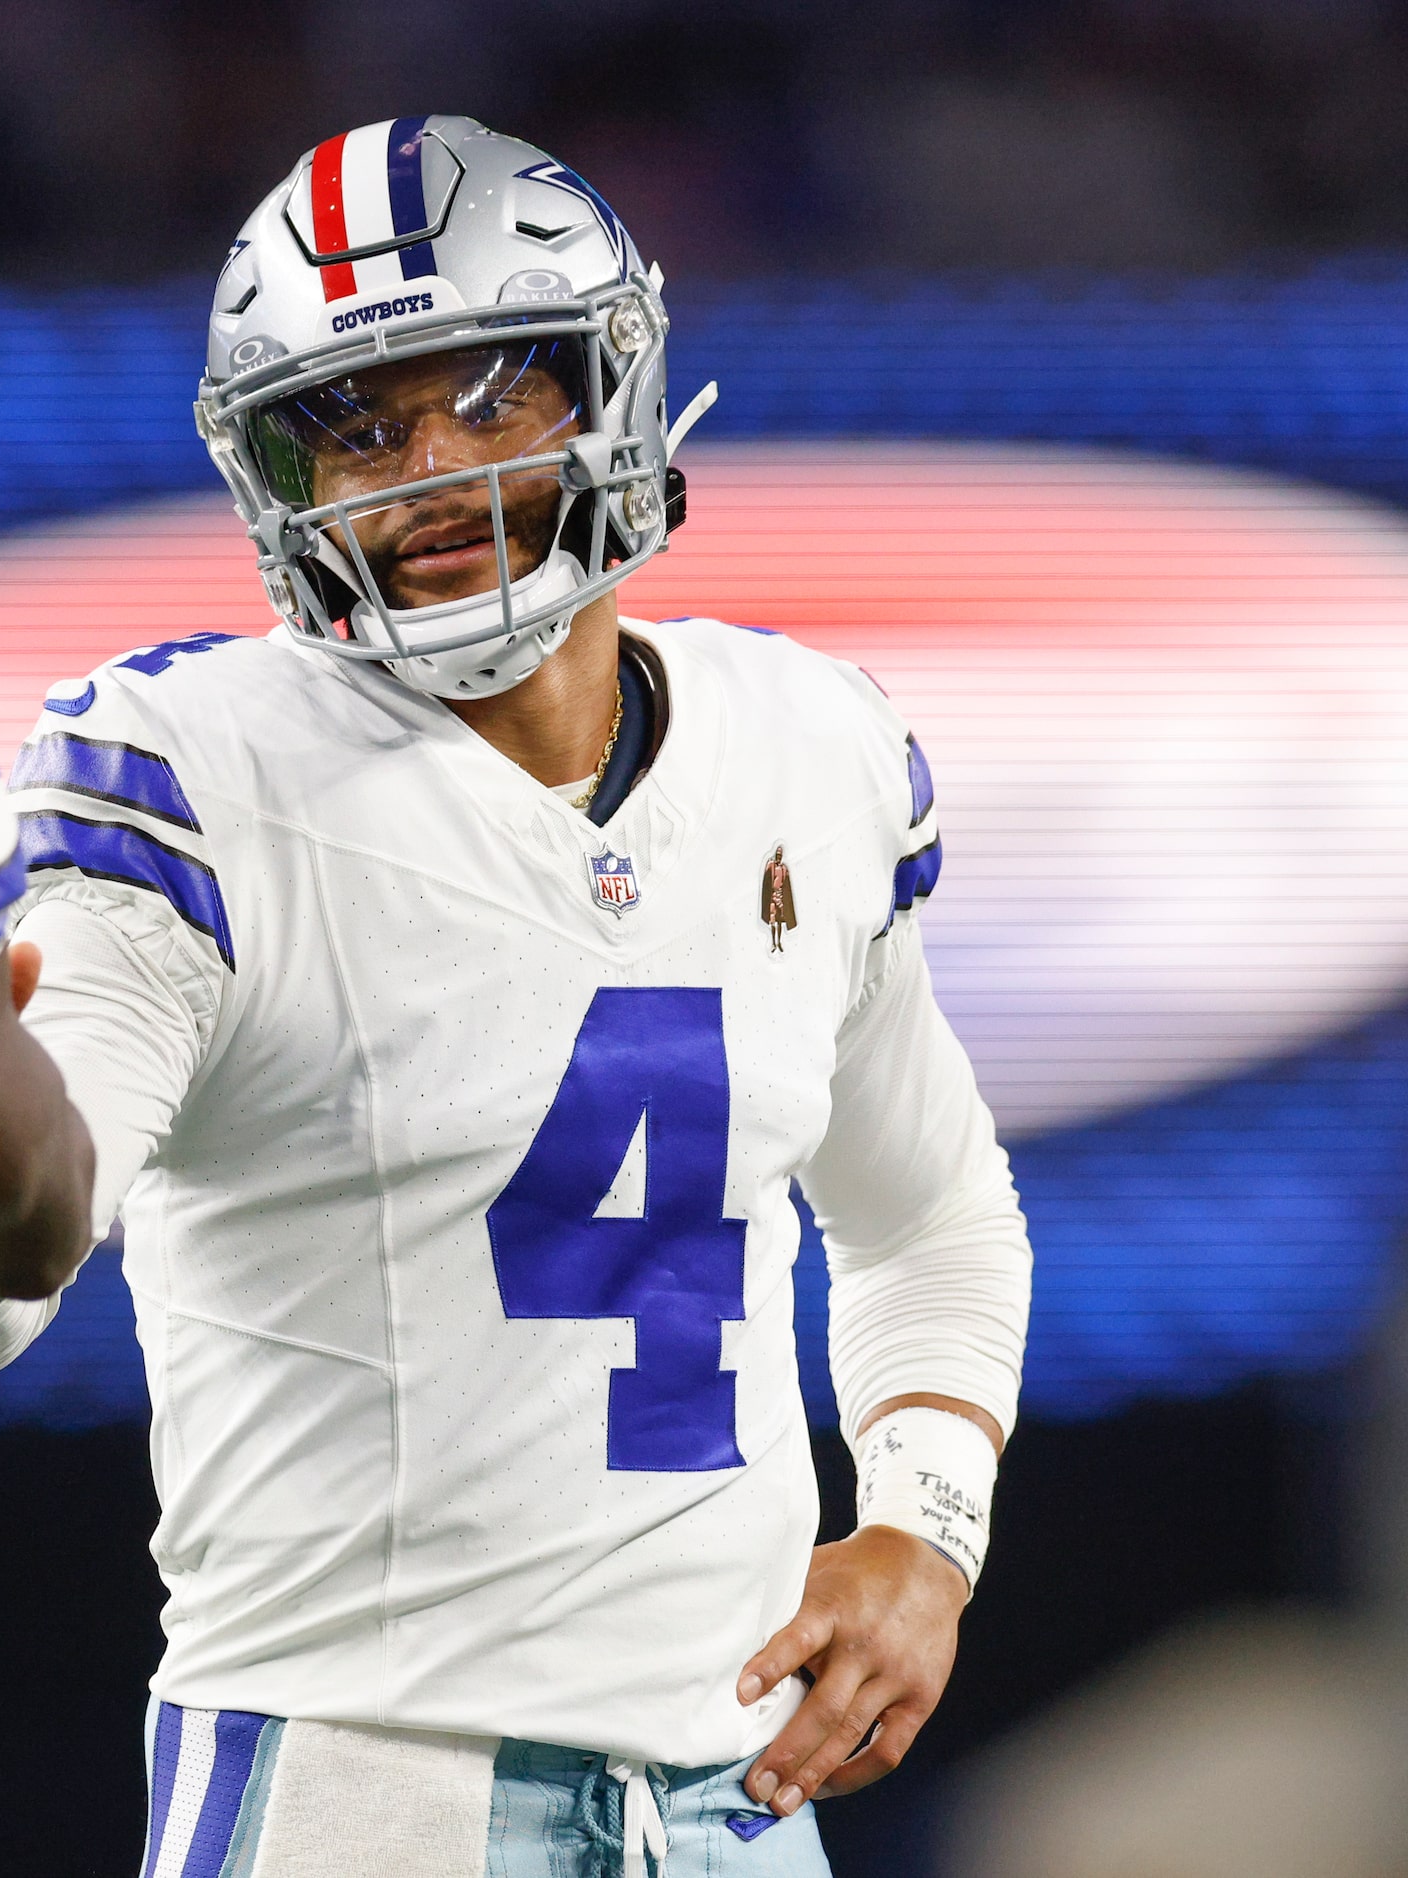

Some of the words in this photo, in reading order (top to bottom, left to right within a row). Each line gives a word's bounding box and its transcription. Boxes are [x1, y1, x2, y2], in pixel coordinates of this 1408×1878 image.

[332, 292, 434, 333] COWBOYS
[598, 875, 635, 904] NFL
[486, 987, 748, 1471] 4
[915, 1471, 987, 1525] THANK
